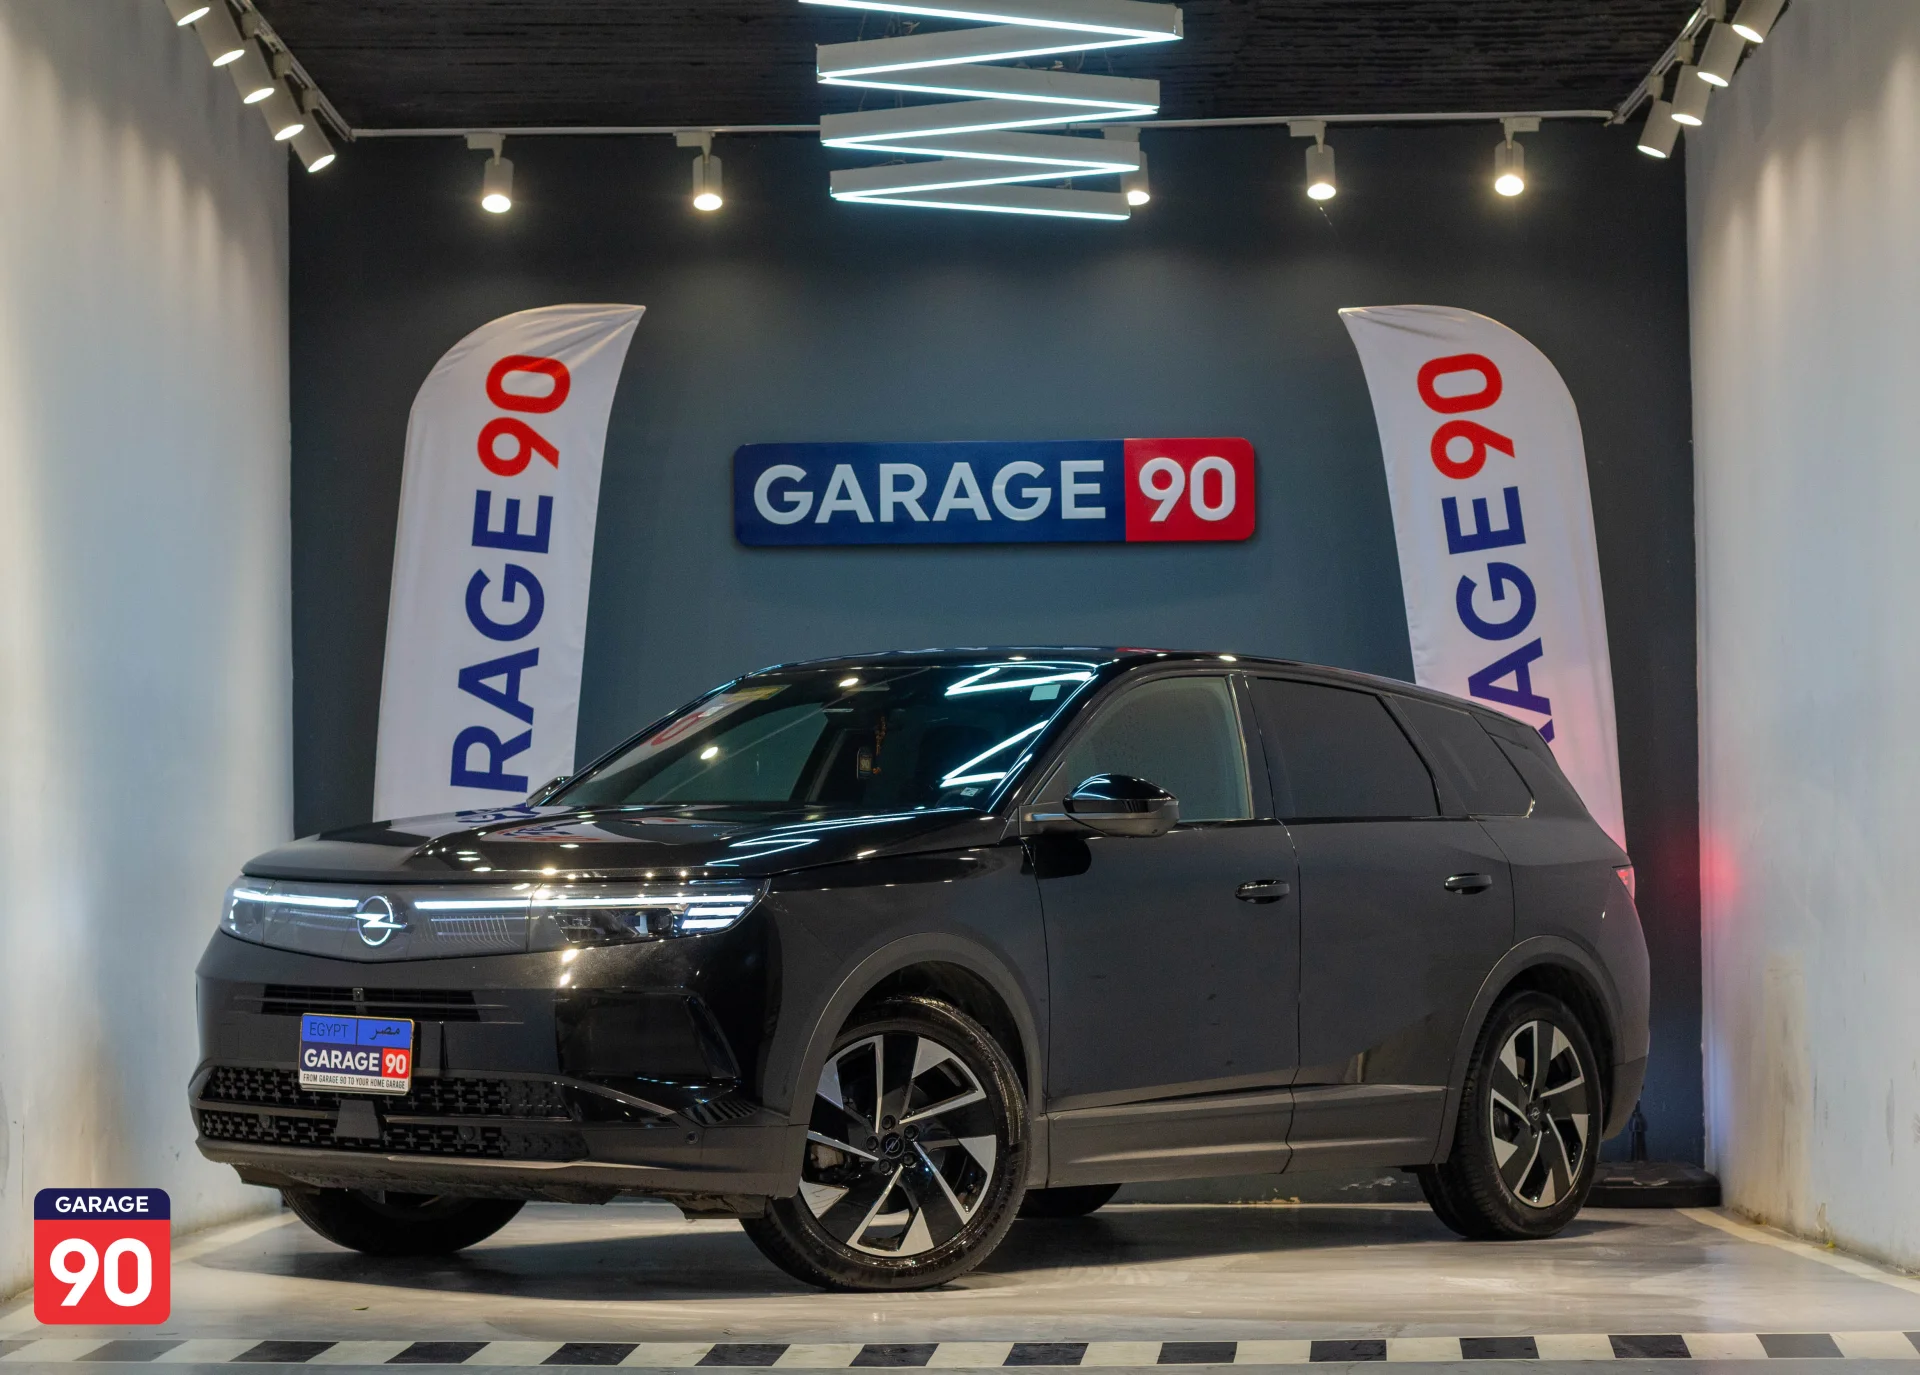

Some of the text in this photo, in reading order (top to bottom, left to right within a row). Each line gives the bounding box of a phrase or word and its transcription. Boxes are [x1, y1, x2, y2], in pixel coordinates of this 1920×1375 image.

[754, 456, 1237, 525] GARAGE 90
[309, 1022, 349, 1037] EGYPT
[369, 1026, 400, 1040] مصر
[304, 1048, 407, 1075] GARAGE 90
[303, 1073, 405, 1089] FROM GARAGE 90 TO YOUR HOME GARAGE
